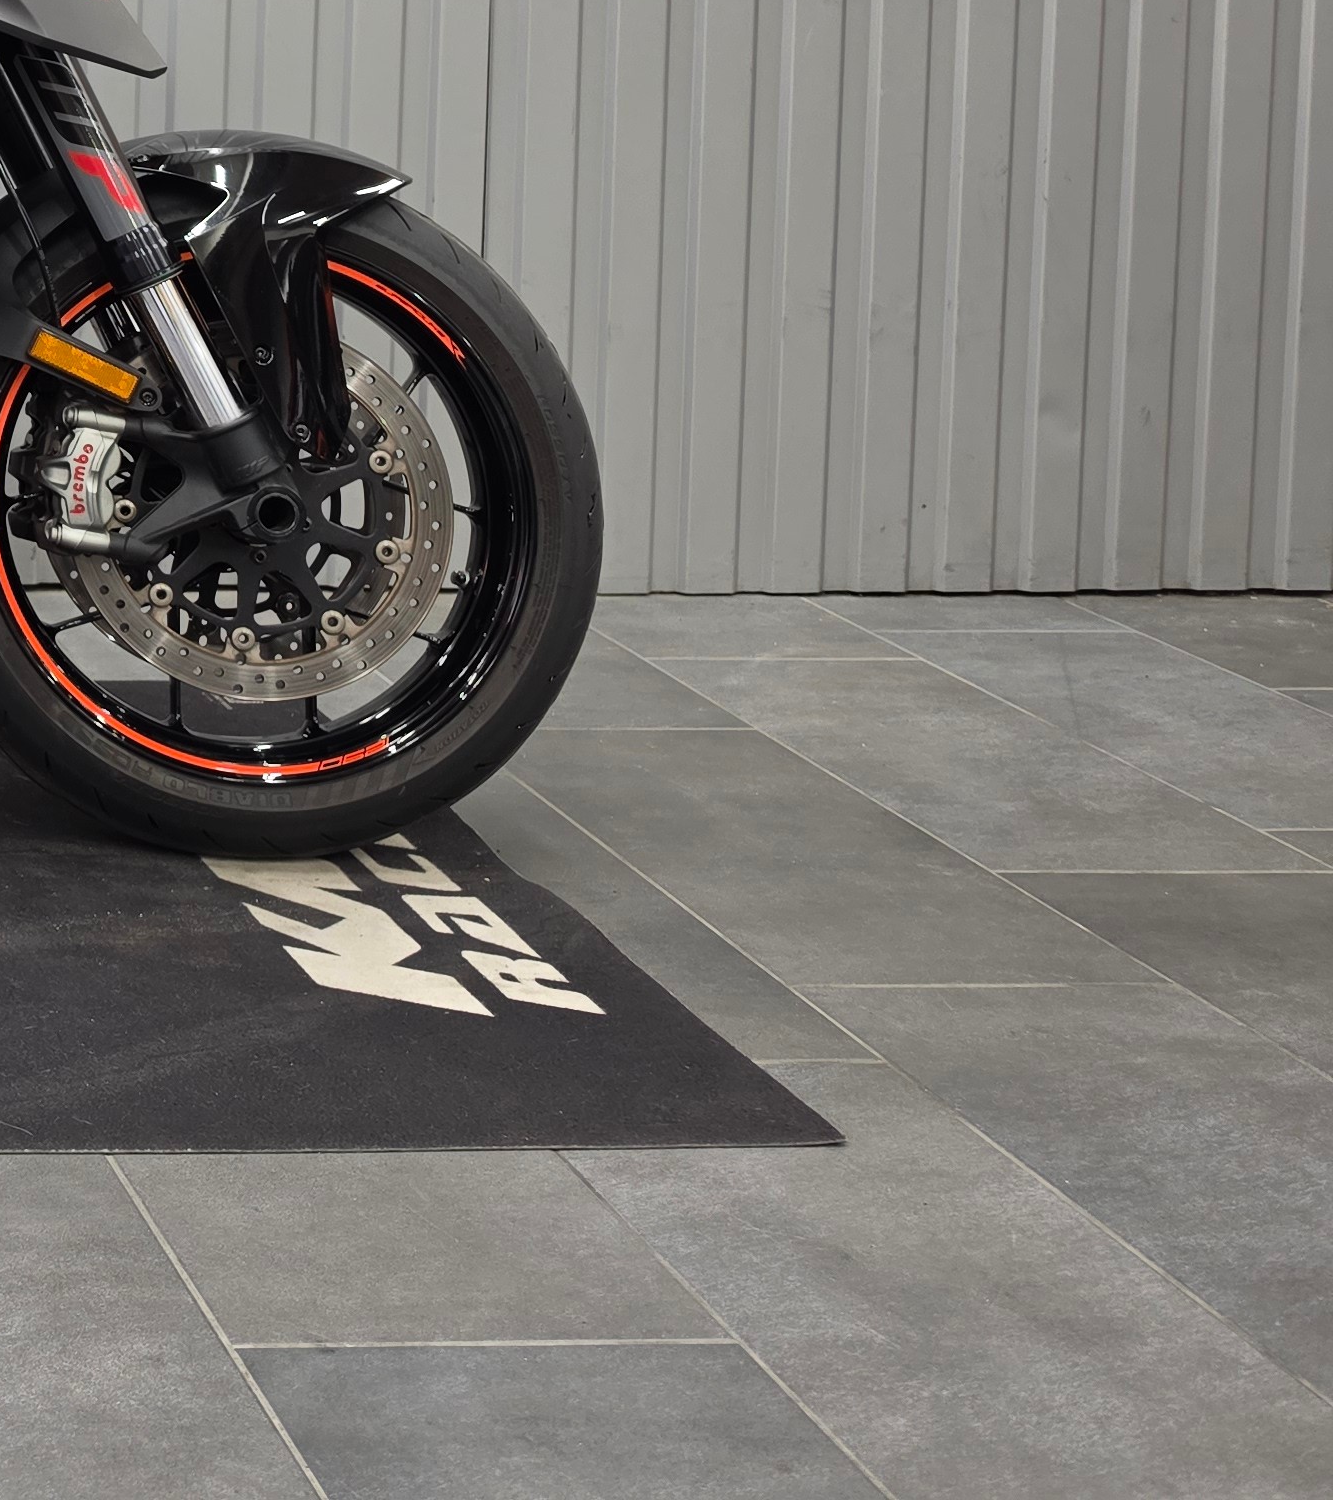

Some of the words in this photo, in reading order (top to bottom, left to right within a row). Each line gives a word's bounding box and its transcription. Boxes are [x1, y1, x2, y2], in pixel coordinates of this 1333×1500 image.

[70, 443, 94, 516] brembo
[162, 775, 293, 809] DIABLO
[200, 856, 495, 1018] KM
